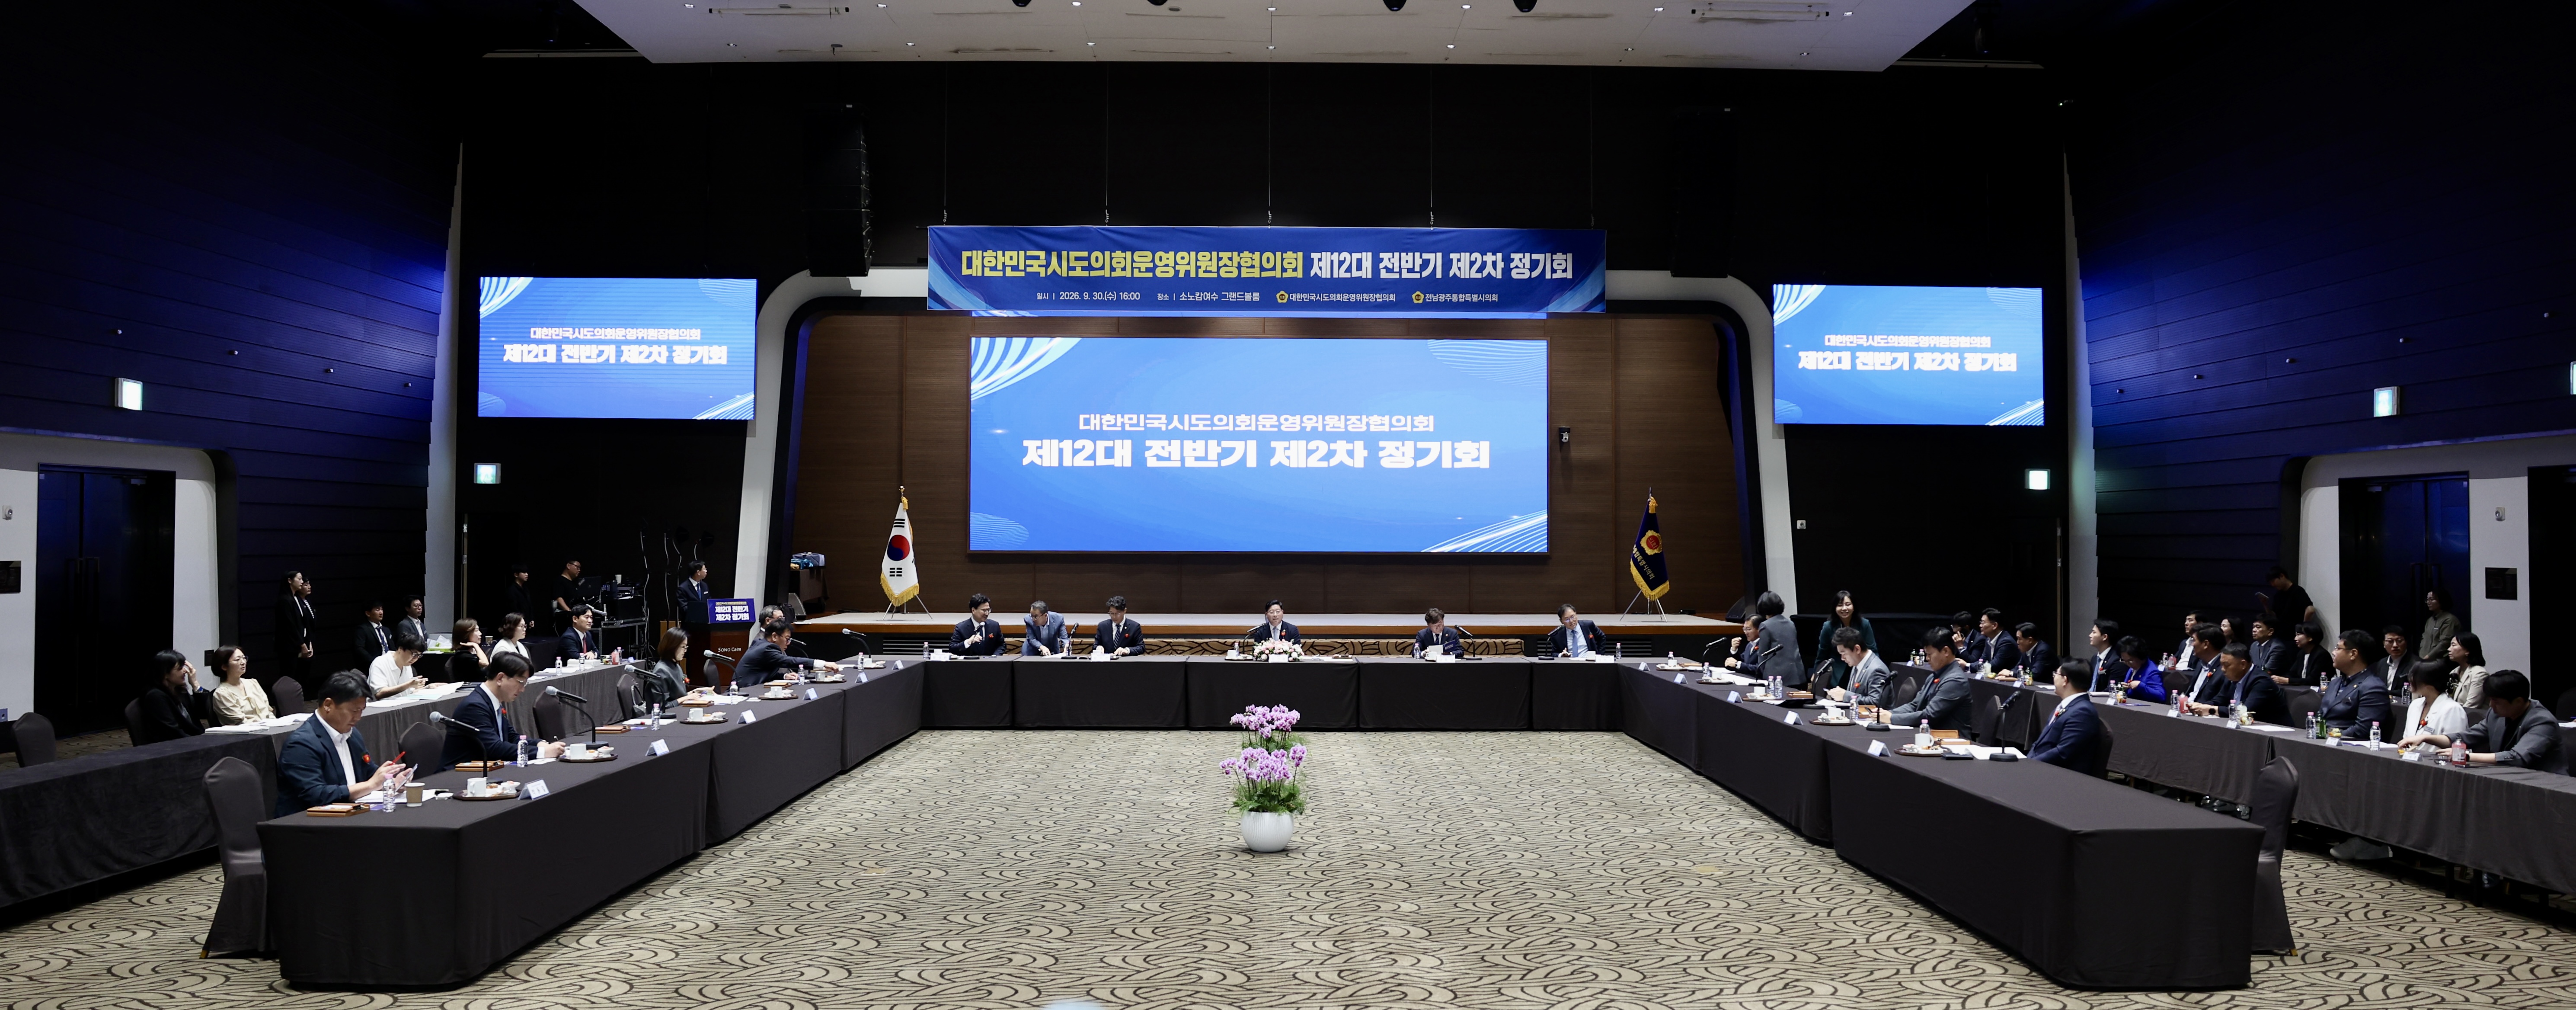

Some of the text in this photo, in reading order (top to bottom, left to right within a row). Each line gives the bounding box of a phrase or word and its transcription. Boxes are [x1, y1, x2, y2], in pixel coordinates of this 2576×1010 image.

[961, 250, 1572, 279] 대한민국시도의회운영위원장협의회 제12대 전반기 제2차 정기회
[1059, 292, 1081, 300] 2026.
[1093, 291, 1116, 301] 30.(수)
[1119, 292, 1140, 300] 16:00
[1179, 292, 1218, 301] 소노캄여수
[1221, 292, 1260, 301] 그랜드볼룸
[1289, 293, 1396, 302] 대한민국시도의회운영위원장협의회
[1425, 294, 1498, 302] 전남광주통합특별시의회
[531, 327, 701, 340] 대한민국시도의회운영위원장협의회
[1825, 334, 1991, 348] 대한민국시도의회운영위원장협의회
[503, 344, 728, 364] 제12대 전반기 제2차 정기회
[1798, 351, 2017, 372] 제12대 전반기 제2차 정기회
[1079, 414, 1434, 432] 대한민국시도의회운영위원장협의회
[1023, 439, 1490, 468] 제12대 전반기 제2차 정기회
